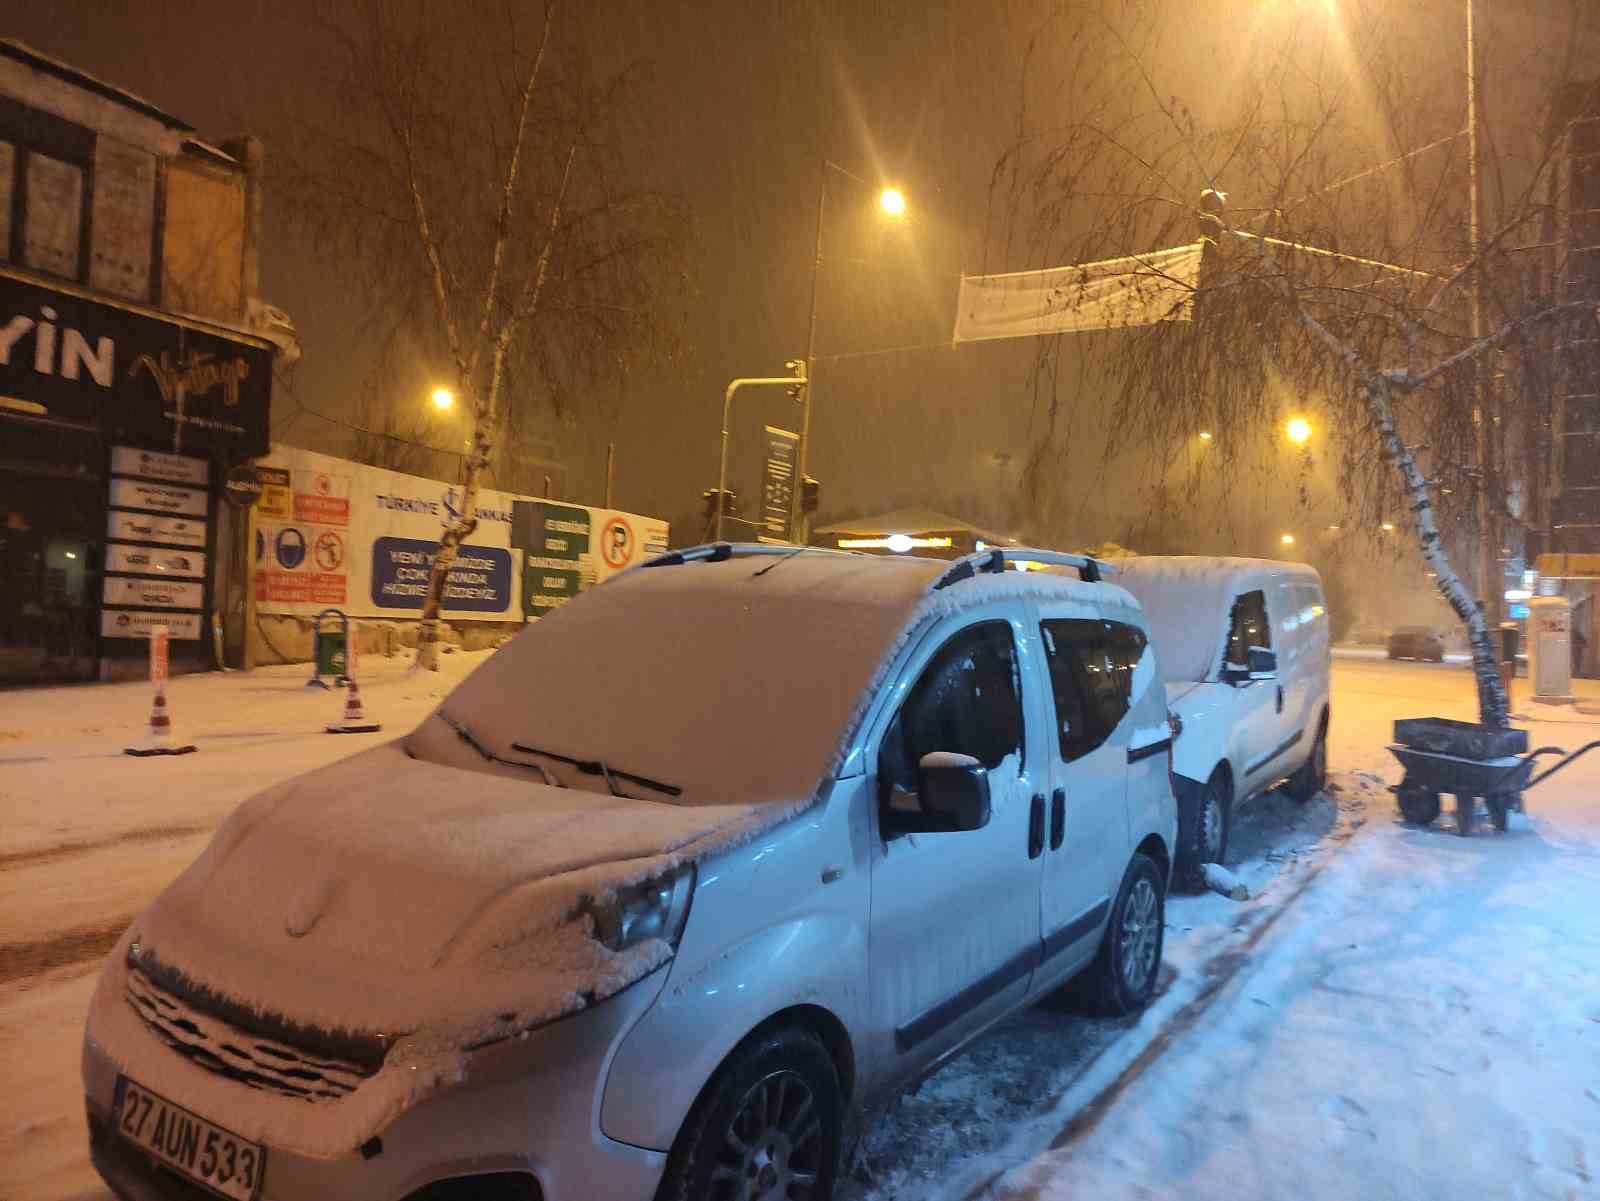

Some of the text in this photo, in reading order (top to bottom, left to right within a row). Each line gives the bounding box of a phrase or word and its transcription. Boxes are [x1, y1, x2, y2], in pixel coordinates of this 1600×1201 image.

[122, 1088, 255, 1190] 27 AUN 533
